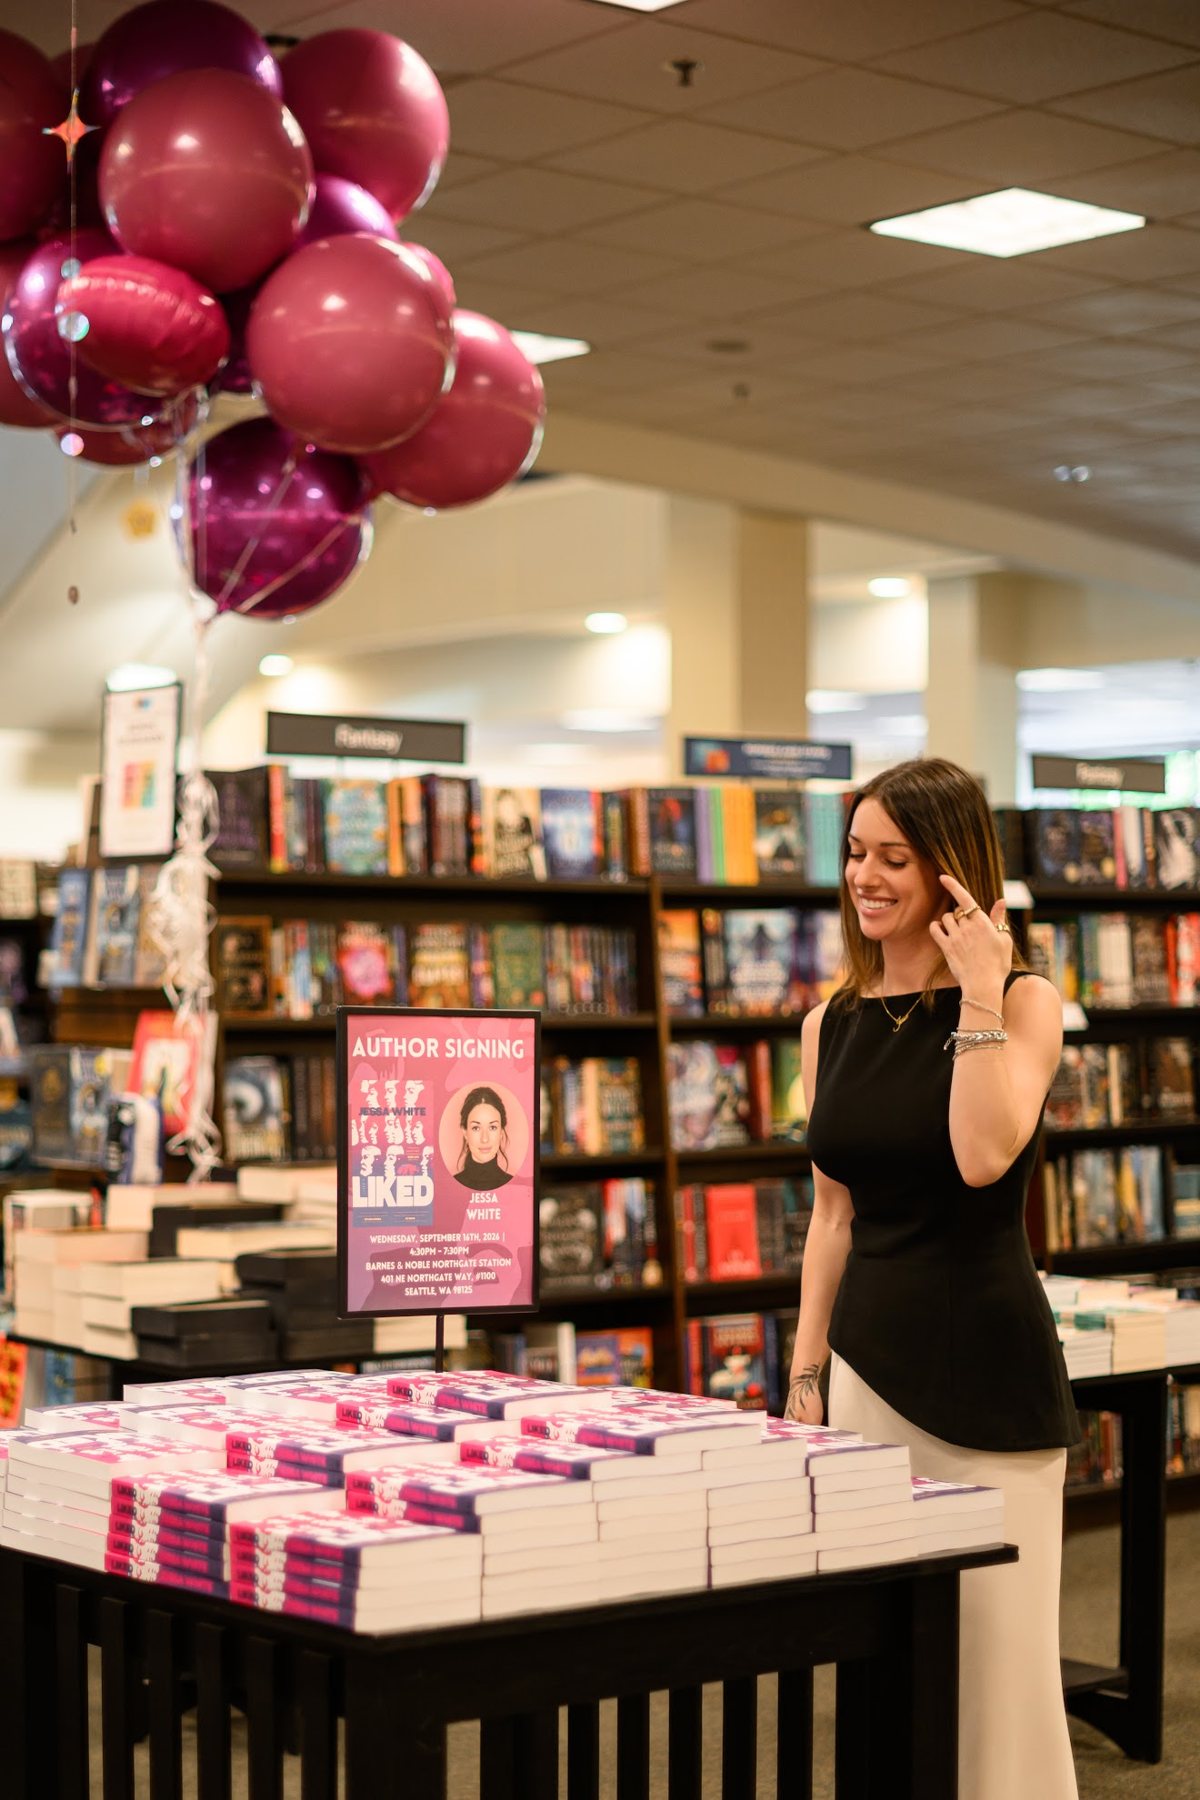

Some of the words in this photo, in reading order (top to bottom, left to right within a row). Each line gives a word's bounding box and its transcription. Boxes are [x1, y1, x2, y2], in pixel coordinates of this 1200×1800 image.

[352, 1036, 439, 1058] AUTHOR
[445, 1038, 525, 1059] SIGNING
[358, 1107, 390, 1116] JESSA
[391, 1107, 426, 1116] WHITE
[352, 1175, 435, 1208] LIKED
[469, 1192, 499, 1204] JESSA
[467, 1208, 501, 1220] WHITE
[369, 1234, 418, 1243] WEDNESDAY,
[419, 1233, 462, 1243] SEPTEMBER
[483, 1232, 500, 1241] 2026
[409, 1247, 437, 1256] 4:30PM
[443, 1246, 470, 1255] 7:30PM
[365, 1261, 395, 1271] BARNES
[396, 1261, 404, 1270] &
[404, 1260, 431, 1270] NOBLE
[432, 1259, 477, 1269] NORTHGATE
[478, 1258, 512, 1267] STATION
[381, 1274, 394, 1284] 401
[395, 1274, 406, 1283] NE
[407, 1273, 453, 1282] NORTHGATE
[475, 1271, 496, 1280] #1100
[404, 1286, 437, 1296] SEATTLE,
[439, 1286, 452, 1294] WA
[342, 1408, 362, 1421] LIKED
